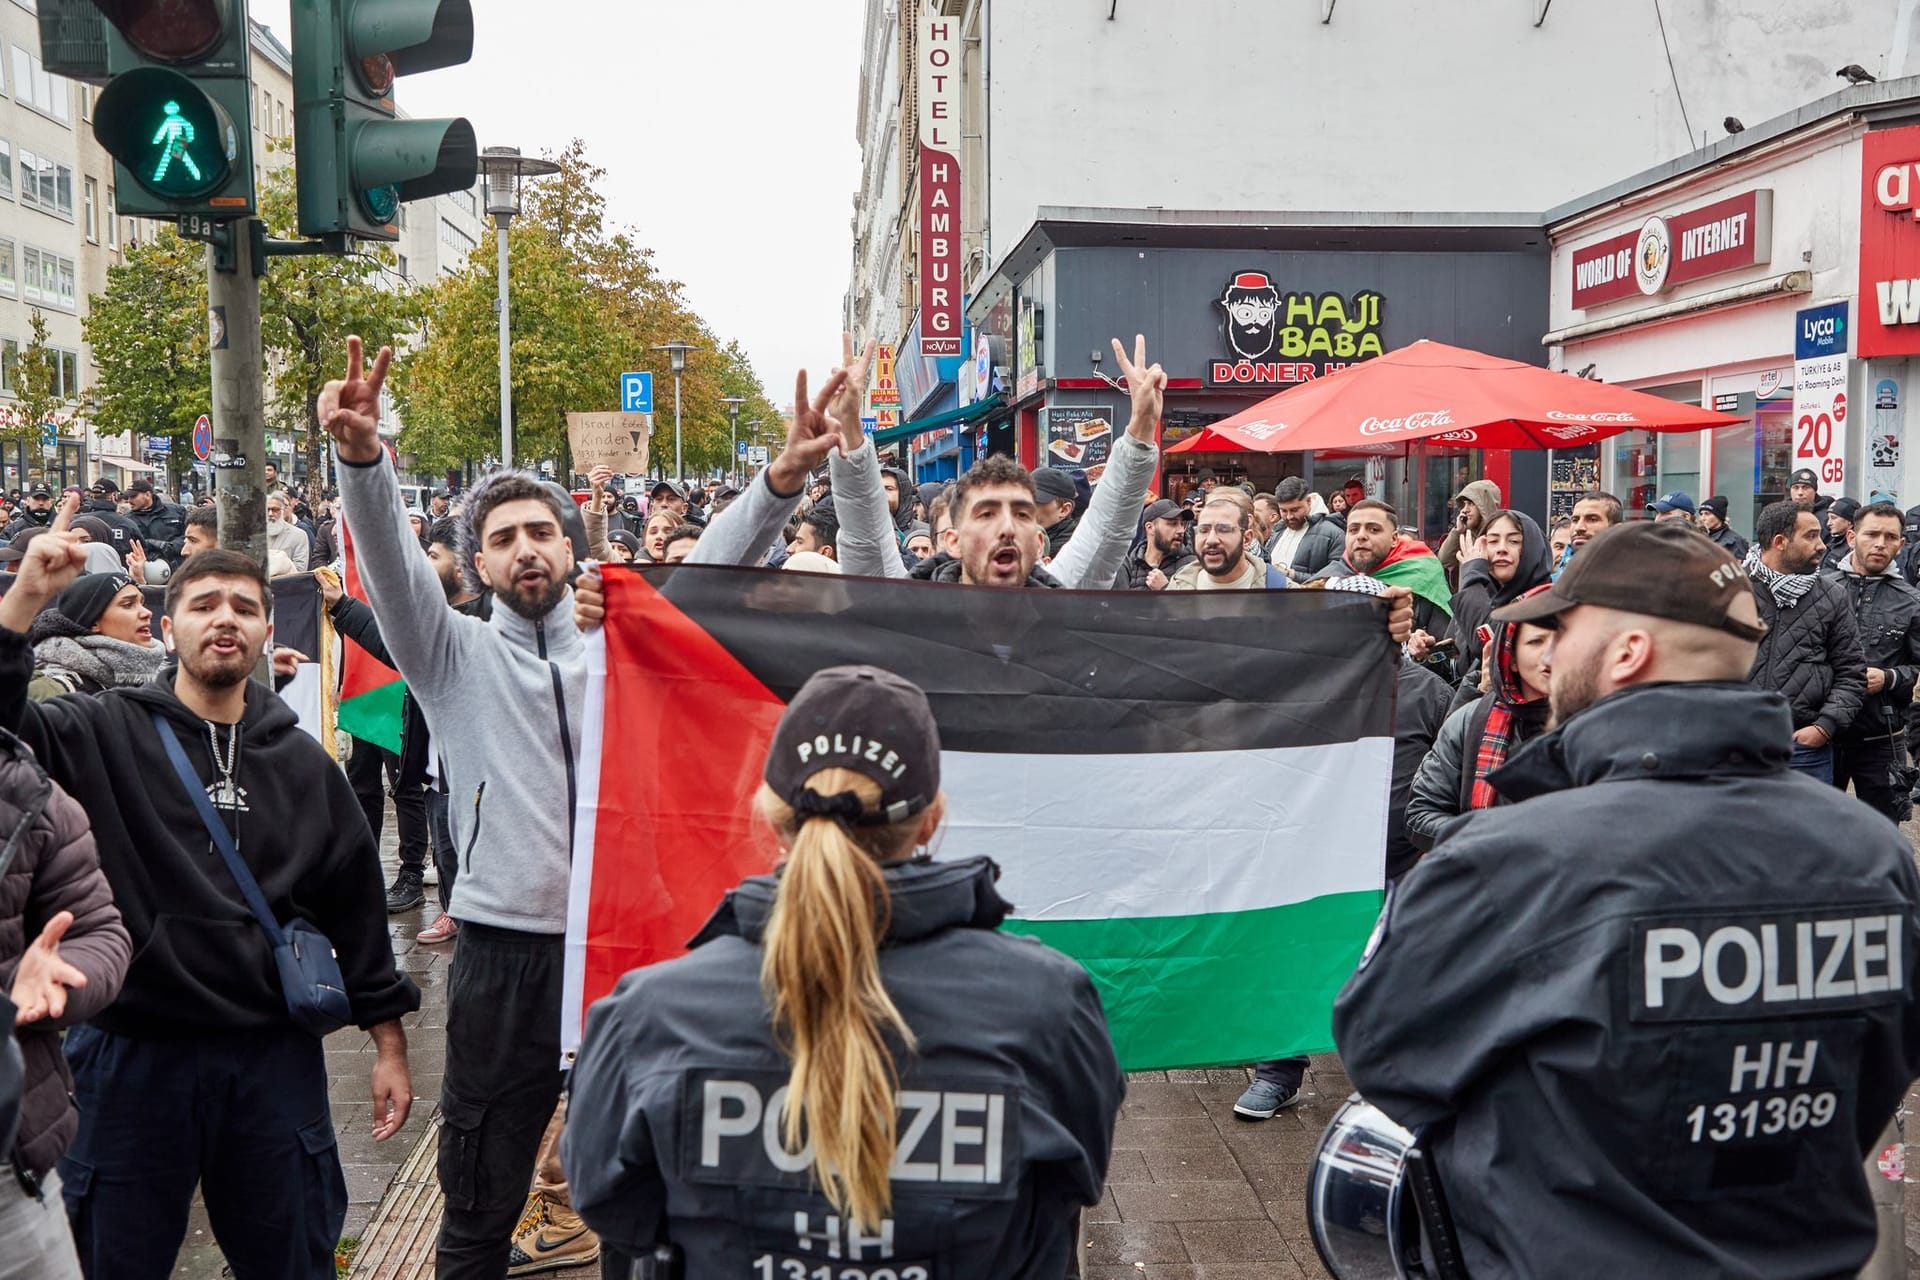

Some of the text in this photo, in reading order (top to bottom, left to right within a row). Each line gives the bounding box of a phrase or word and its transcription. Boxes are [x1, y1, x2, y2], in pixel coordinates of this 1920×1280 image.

[929, 23, 950, 332] HOTEL HAMBURG
[1681, 212, 1748, 262] INTERNET
[1576, 248, 1632, 291] WORLD OF
[1286, 293, 1380, 334] HAJI
[1804, 317, 1835, 342] Lyca
[1279, 326, 1383, 357] BABA
[1816, 335, 1834, 346] Mobile
[1213, 358, 1317, 383] DÖNER
[626, 378, 643, 408] P
[580, 416, 615, 430] Israel
[580, 432, 630, 447] Kinder
[1797, 412, 1832, 458] 20
[1821, 457, 1844, 483] GB
[797, 733, 907, 779] POLIZEI
[1645, 914, 1903, 1009] POLIZEI
[1729, 1040, 1819, 1093] HH
[700, 1079, 1005, 1185] POZEI
[1686, 1092, 1837, 1143] 131369
